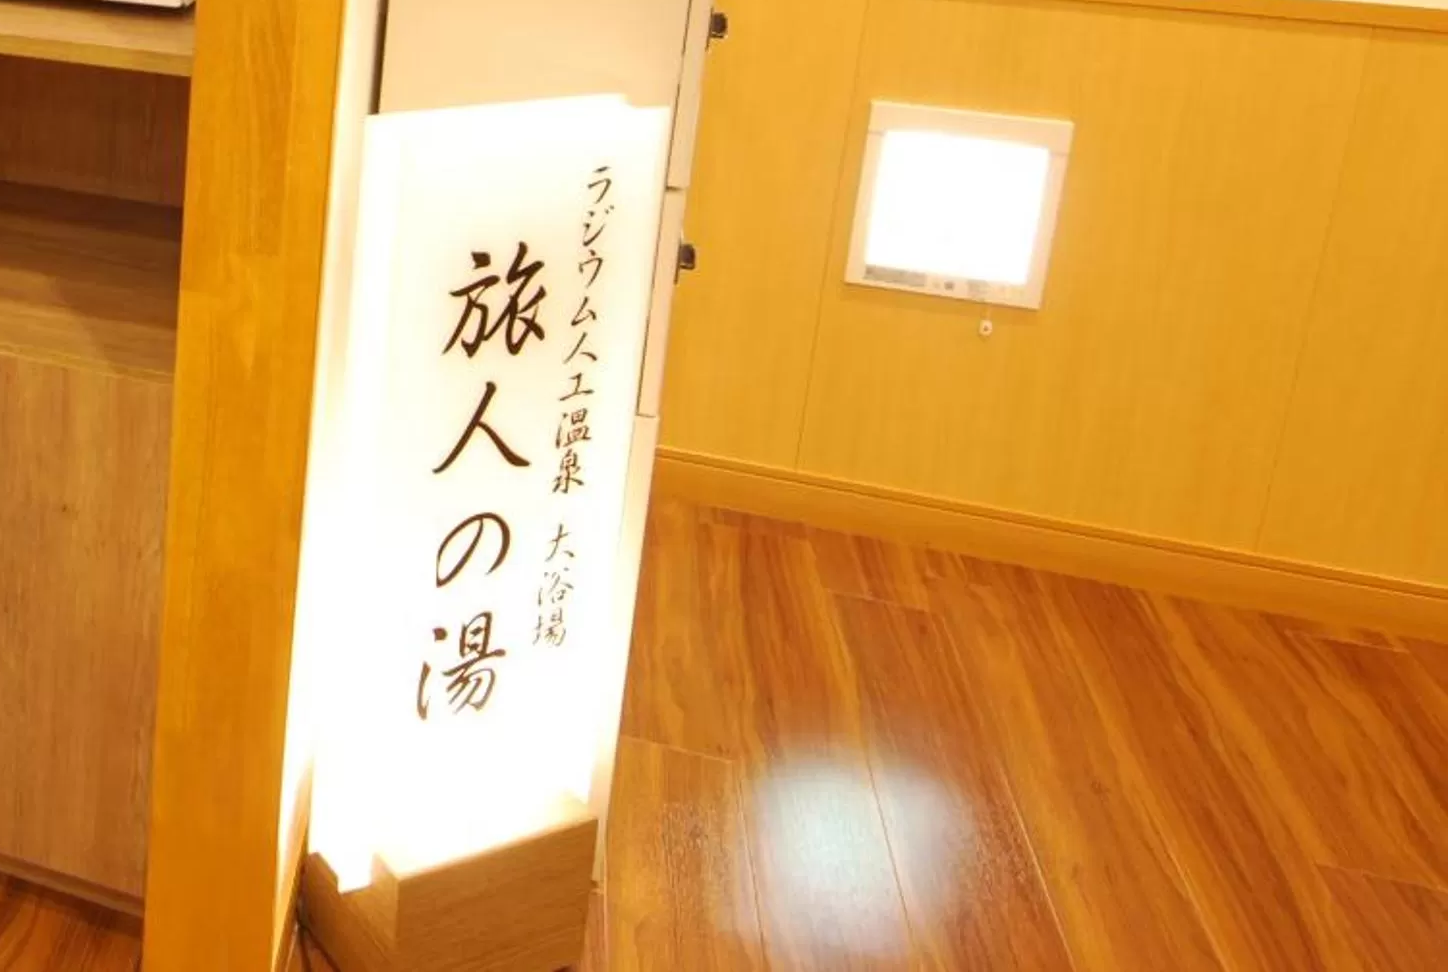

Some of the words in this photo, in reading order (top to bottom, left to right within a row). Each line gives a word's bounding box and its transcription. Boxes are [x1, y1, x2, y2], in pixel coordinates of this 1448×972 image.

[416, 240, 548, 721] 旅人の湯
[532, 522, 575, 648] 大浴場
